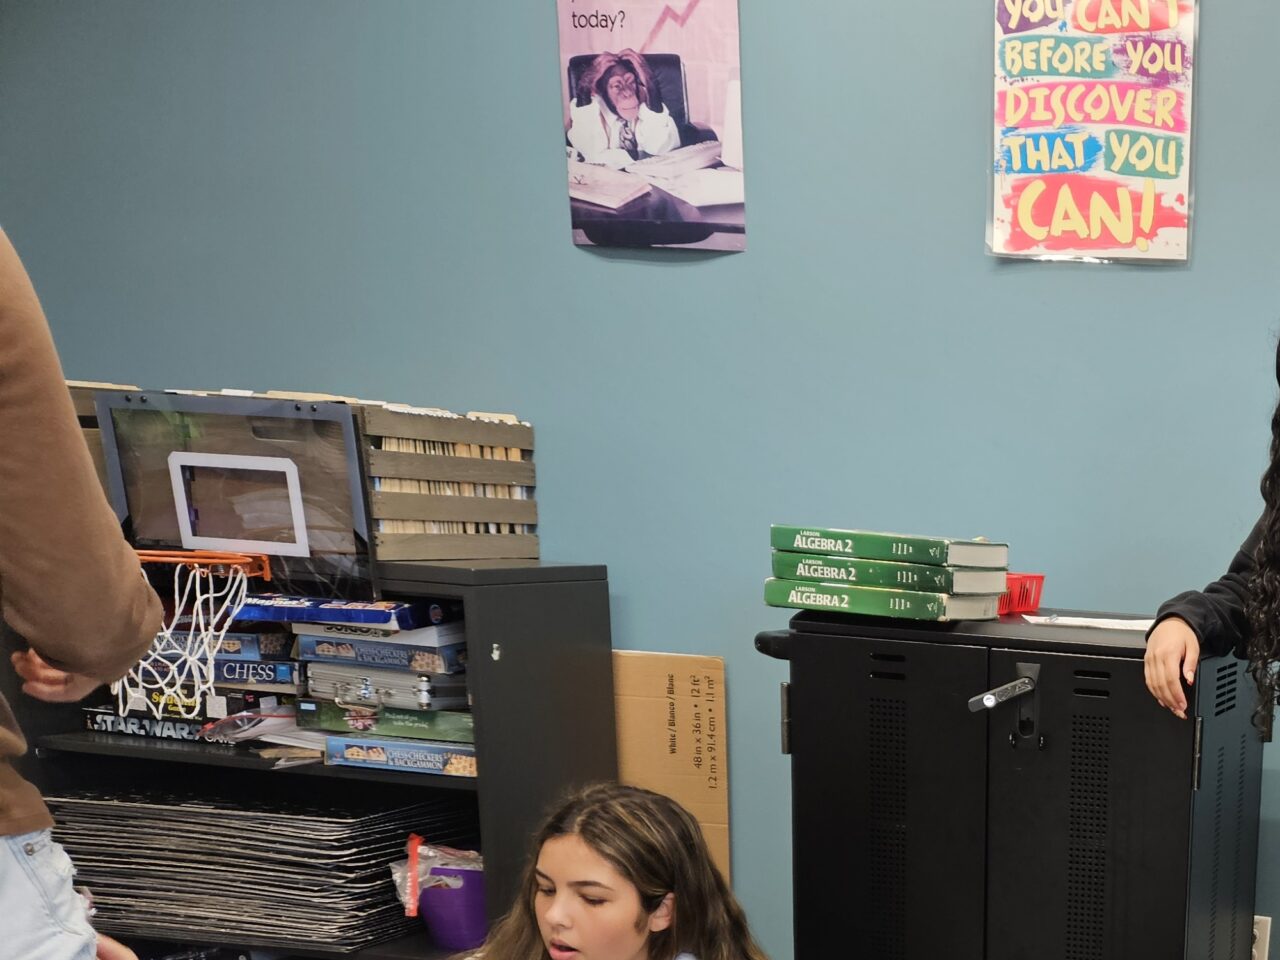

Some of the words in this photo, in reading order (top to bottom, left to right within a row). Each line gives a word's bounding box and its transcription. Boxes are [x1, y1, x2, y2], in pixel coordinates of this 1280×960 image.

[571, 11, 626, 31] today?
[1003, 0, 1065, 29] YOU
[1075, 0, 1180, 32] CANT
[1004, 38, 1106, 75] BEFORE
[1124, 40, 1183, 75] YOU
[1004, 83, 1178, 129] DISCOVER
[1002, 131, 1090, 171] THAT
[1109, 131, 1178, 176] YOU
[1016, 179, 1156, 253] CAN!
[793, 534, 844, 551] ALGEBRA
[844, 539, 853, 553] 2
[796, 563, 848, 580] ALGEBRA
[848, 567, 856, 581] 2
[788, 590, 840, 607] ALGEBRA
[840, 594, 849, 608] 2
[223, 663, 274, 681] CHESS
[666, 673, 675, 695] Blanc
[691, 688, 700, 698] 12
[667, 702, 676, 727] Blanco
[708, 716, 715, 732] cm
[669, 734, 677, 755] White
[707, 733, 716, 753] 91.4
[708, 776, 717, 789] 1.2
